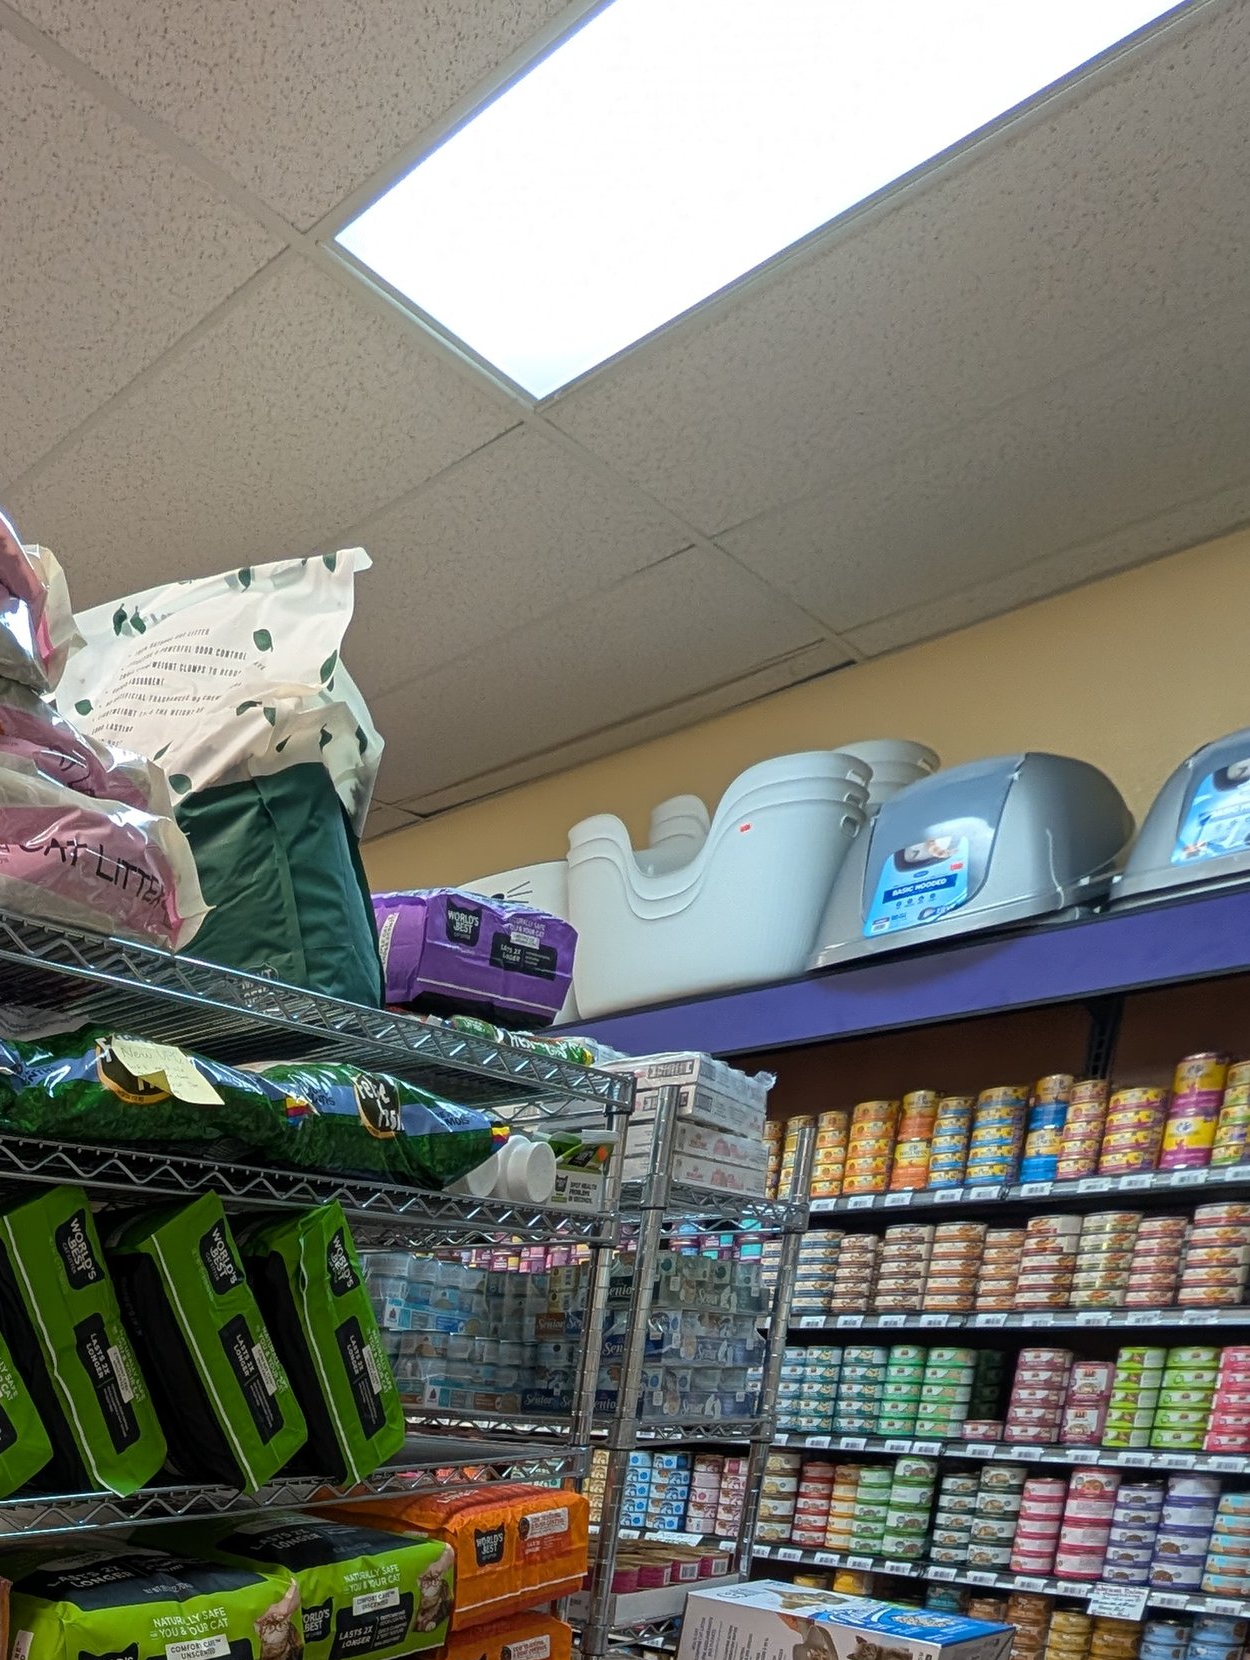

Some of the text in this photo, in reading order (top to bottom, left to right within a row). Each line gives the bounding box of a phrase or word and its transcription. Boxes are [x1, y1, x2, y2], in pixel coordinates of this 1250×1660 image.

[892, 885, 914, 897] BASIC
[448, 910, 480, 925] WORLD'S
[453, 922, 474, 934] BEST
[475, 1532, 503, 1548] WORLD'S
